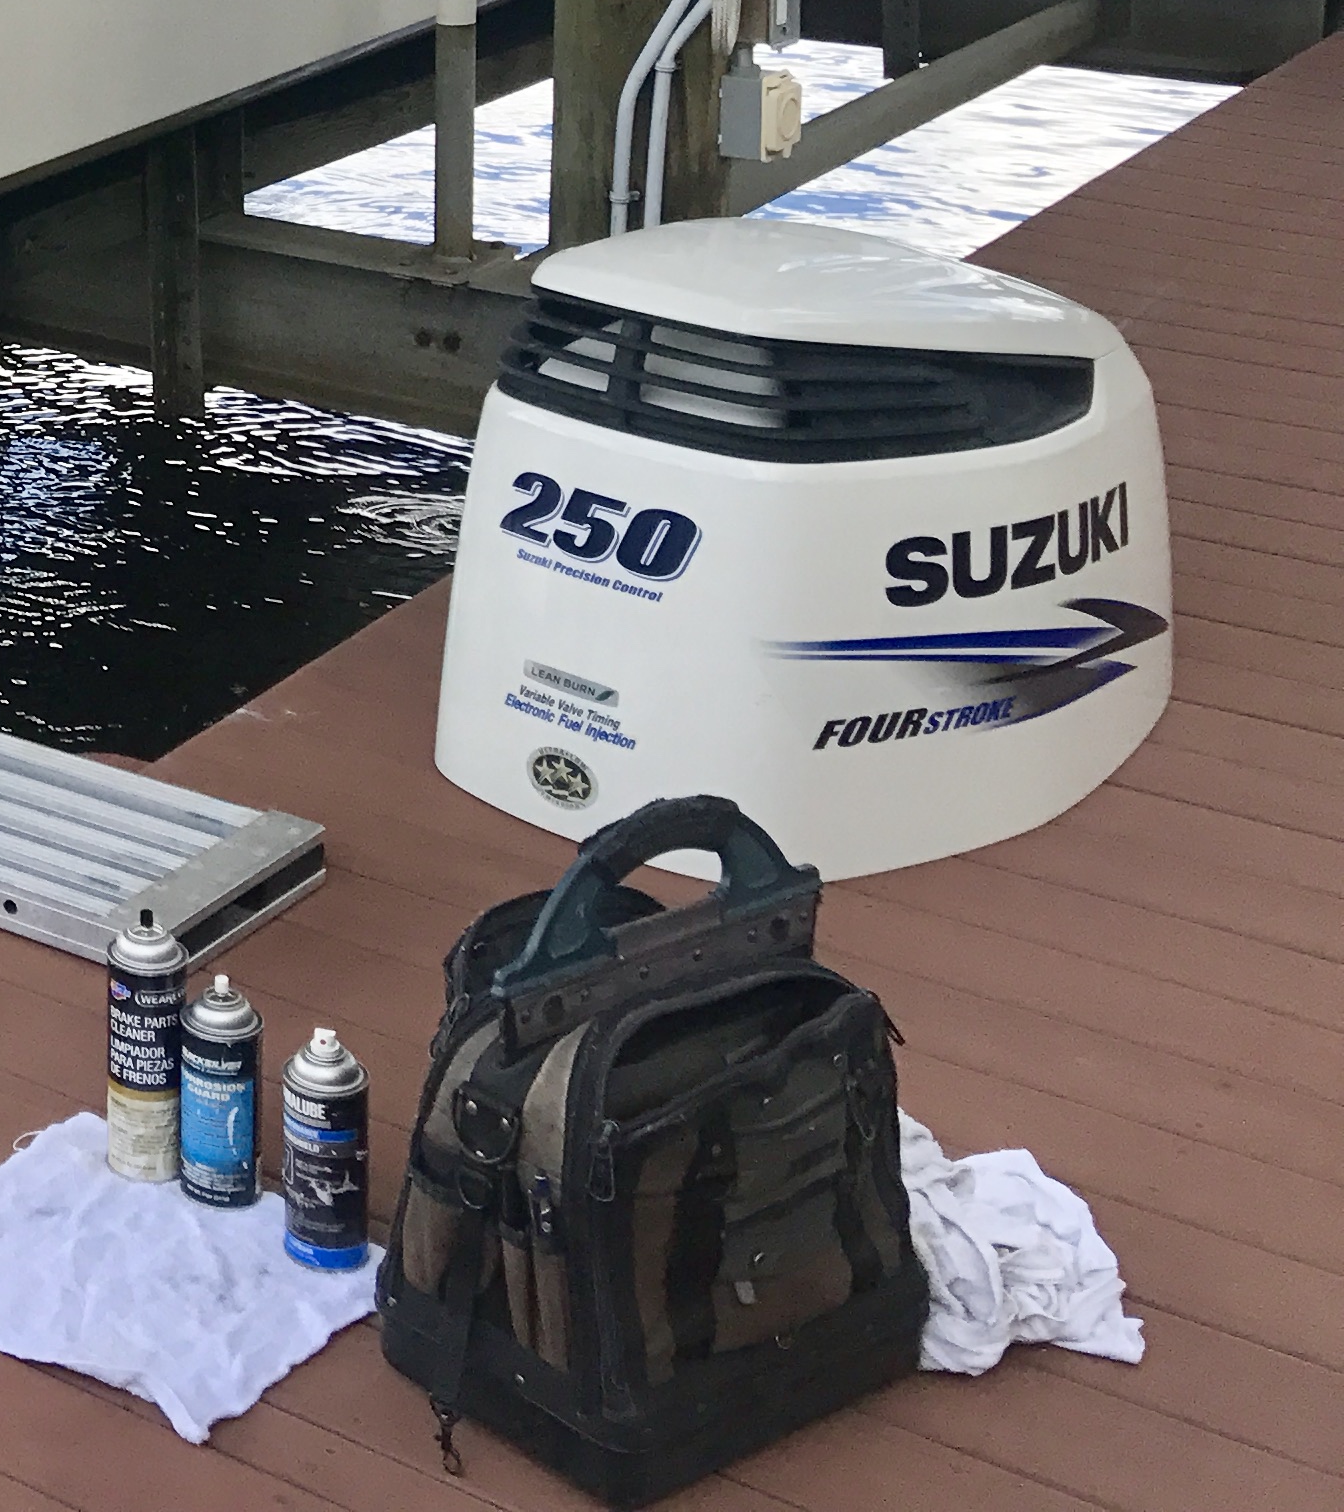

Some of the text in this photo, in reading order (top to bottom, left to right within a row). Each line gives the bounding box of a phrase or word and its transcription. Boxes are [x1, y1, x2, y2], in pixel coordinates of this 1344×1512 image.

[499, 472, 703, 582] 250
[885, 481, 1129, 608] SUZUKI
[516, 548, 664, 603] Suzuki Precision Control
[531, 666, 596, 697] LEAN BURN
[519, 684, 621, 731] Variable Valve Timing
[504, 693, 637, 751] Electronic Fuel Injection
[110, 1004, 178, 1029] BRAKE PARTS
[110, 1019, 156, 1042] CLEANER
[110, 1034, 166, 1059] LIMPIADOR
[110, 1047, 174, 1072] PARA PIEZAS
[110, 1060, 167, 1085] DE FRENOS
[187, 1082, 231, 1102] GUARD
